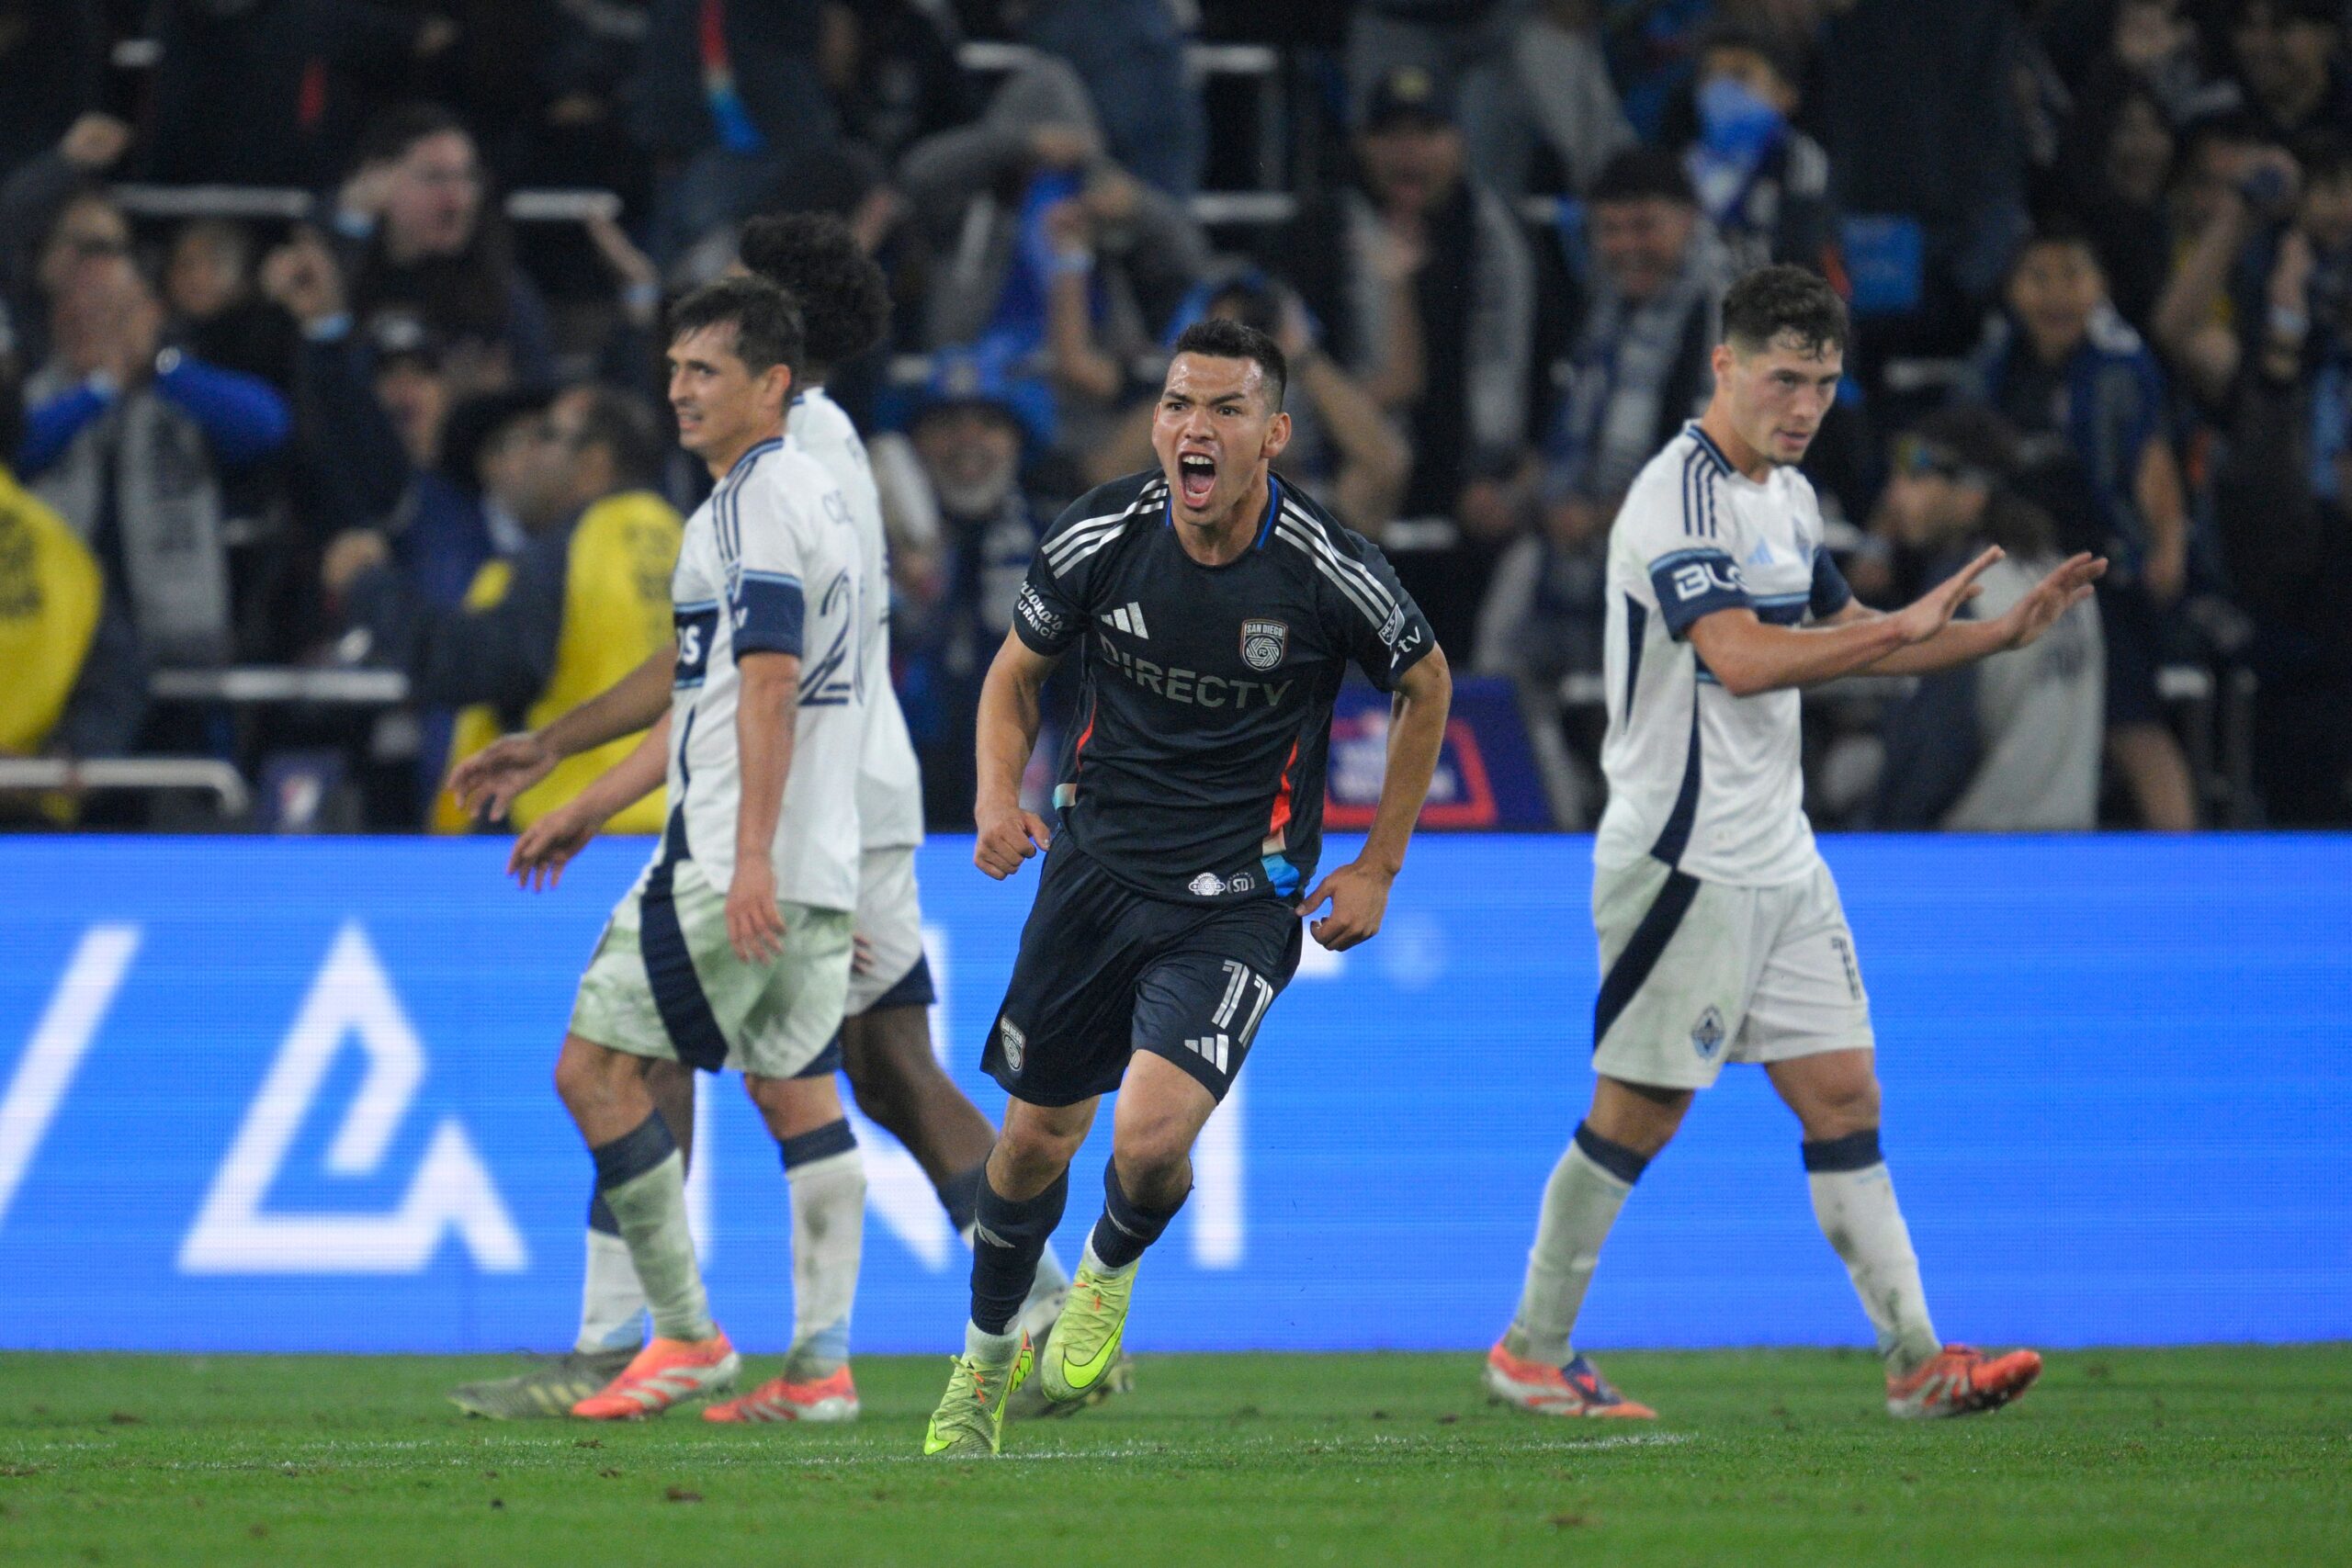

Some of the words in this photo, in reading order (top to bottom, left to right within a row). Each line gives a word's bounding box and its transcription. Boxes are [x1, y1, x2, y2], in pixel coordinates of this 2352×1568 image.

[1017, 595, 1059, 641] URANCE
[1246, 624, 1262, 634] SAN
[1262, 624, 1283, 637] DIEGO
[1098, 632, 1295, 709] DIRECTV
[1232, 877, 1250, 893] SD
